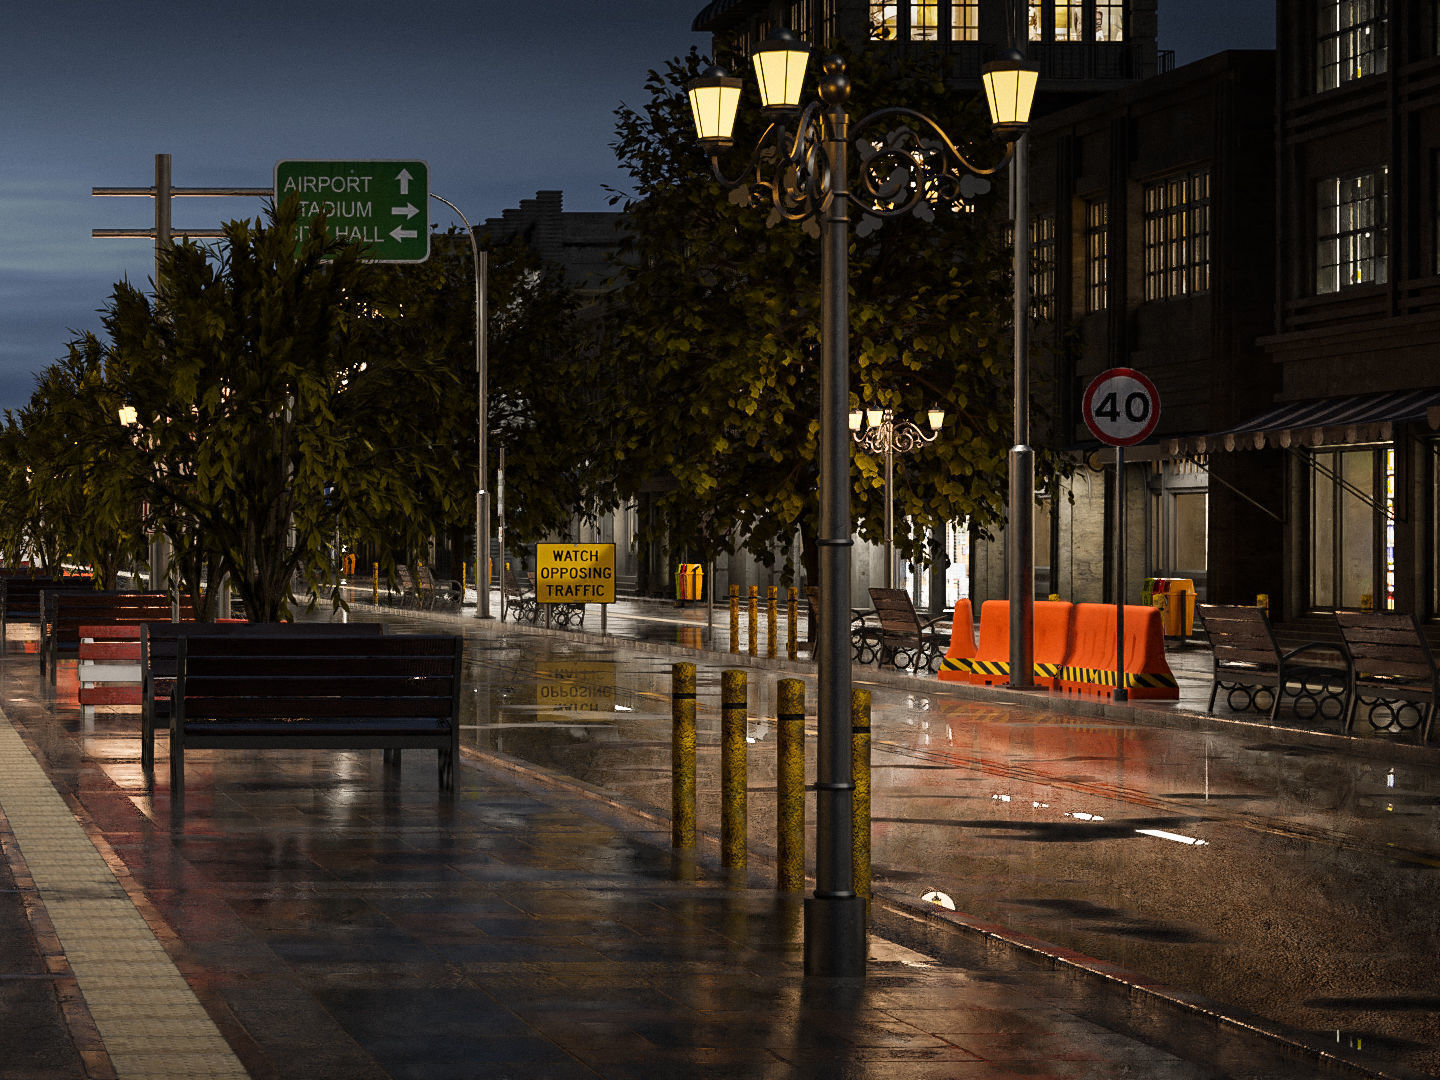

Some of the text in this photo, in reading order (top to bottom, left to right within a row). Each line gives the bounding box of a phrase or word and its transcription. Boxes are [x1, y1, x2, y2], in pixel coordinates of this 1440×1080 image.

[283, 176, 373, 193] AIRPORT
[298, 201, 372, 218] TADIUM
[335, 225, 385, 242] HALL
[1094, 391, 1150, 423] 40
[552, 550, 599, 562] WATCH
[540, 567, 612, 579] OPPOSING
[546, 585, 605, 597] TRAFFIC
